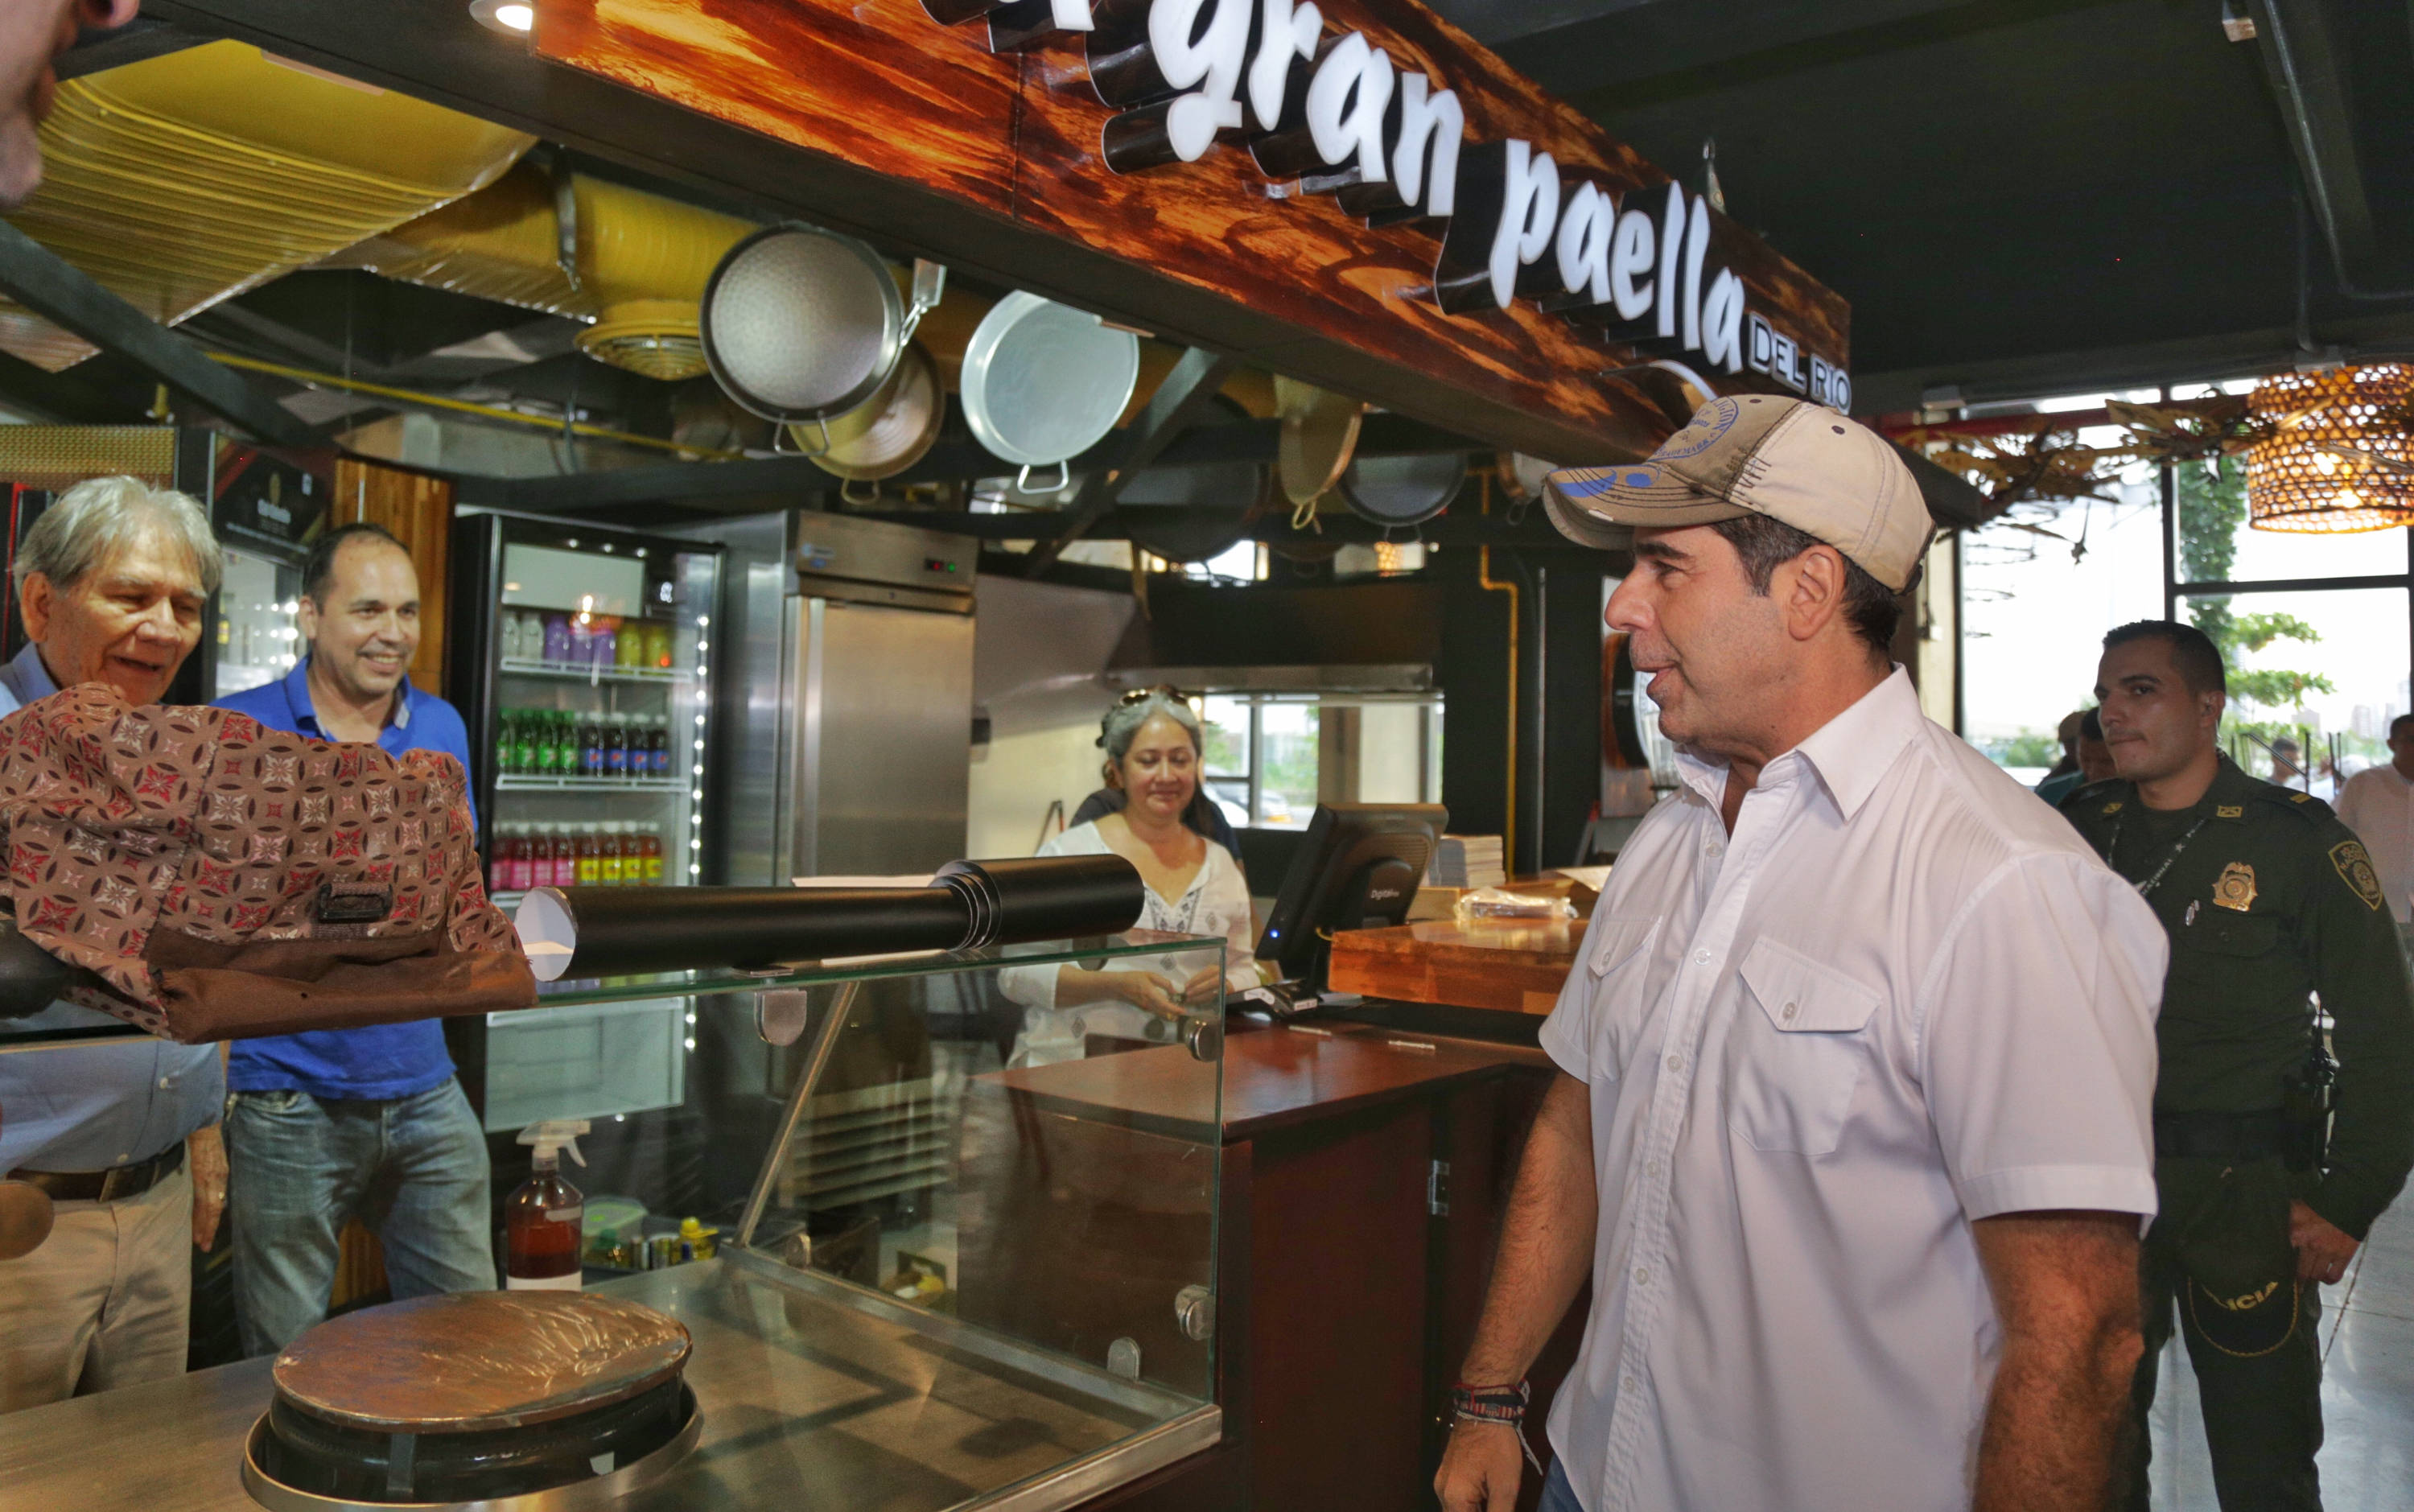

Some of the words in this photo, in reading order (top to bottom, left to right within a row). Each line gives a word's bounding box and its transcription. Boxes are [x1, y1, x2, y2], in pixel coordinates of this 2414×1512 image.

[1148, 0, 1464, 216] gran
[1489, 138, 1745, 375] paella
[1750, 314, 1806, 392] DEL
[1812, 356, 1851, 413] RIO
